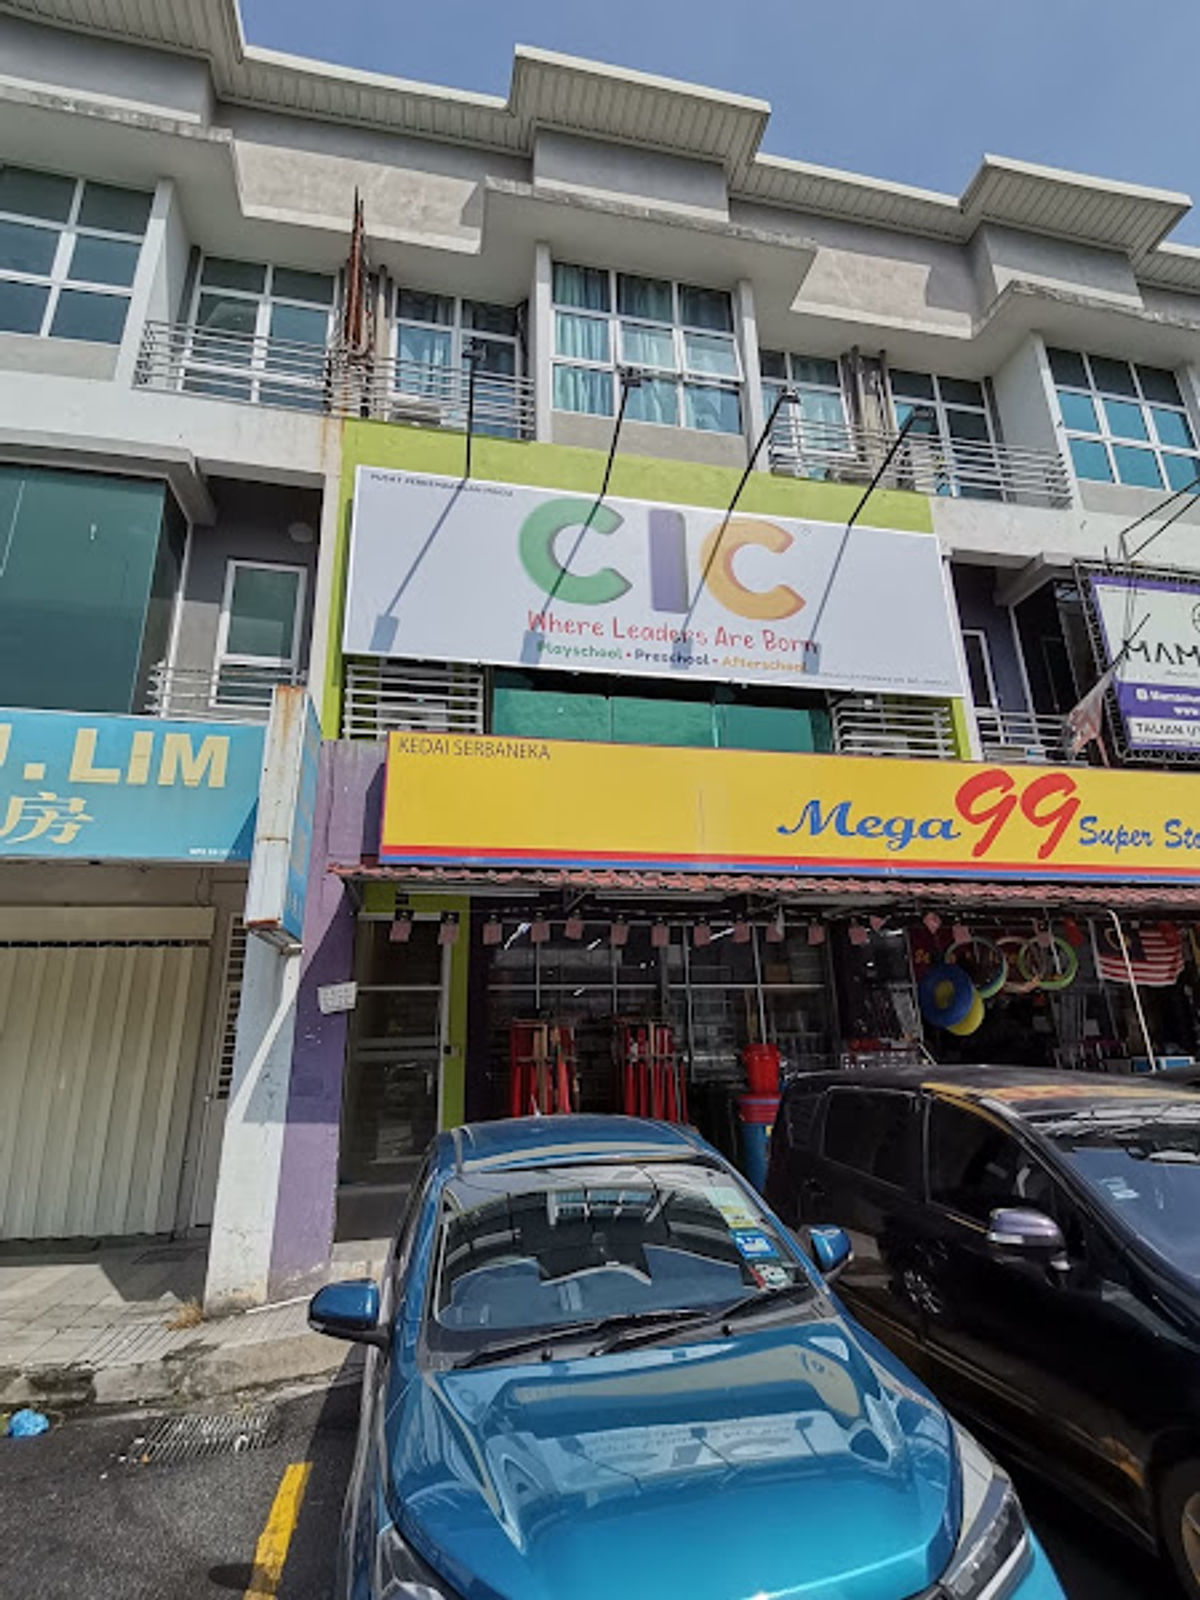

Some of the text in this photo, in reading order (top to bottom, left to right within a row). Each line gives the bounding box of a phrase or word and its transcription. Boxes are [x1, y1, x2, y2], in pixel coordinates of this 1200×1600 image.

[519, 498, 807, 620] CIC
[528, 610, 818, 654] Where Leaders Are Born
[536, 639, 807, 673] Playschool Preschool Afterschool
[398, 737, 551, 761] KEDAI SERBANEKA
[776, 799, 961, 852] Mega
[954, 768, 1082, 860] 99
[1079, 815, 1153, 854] Super
